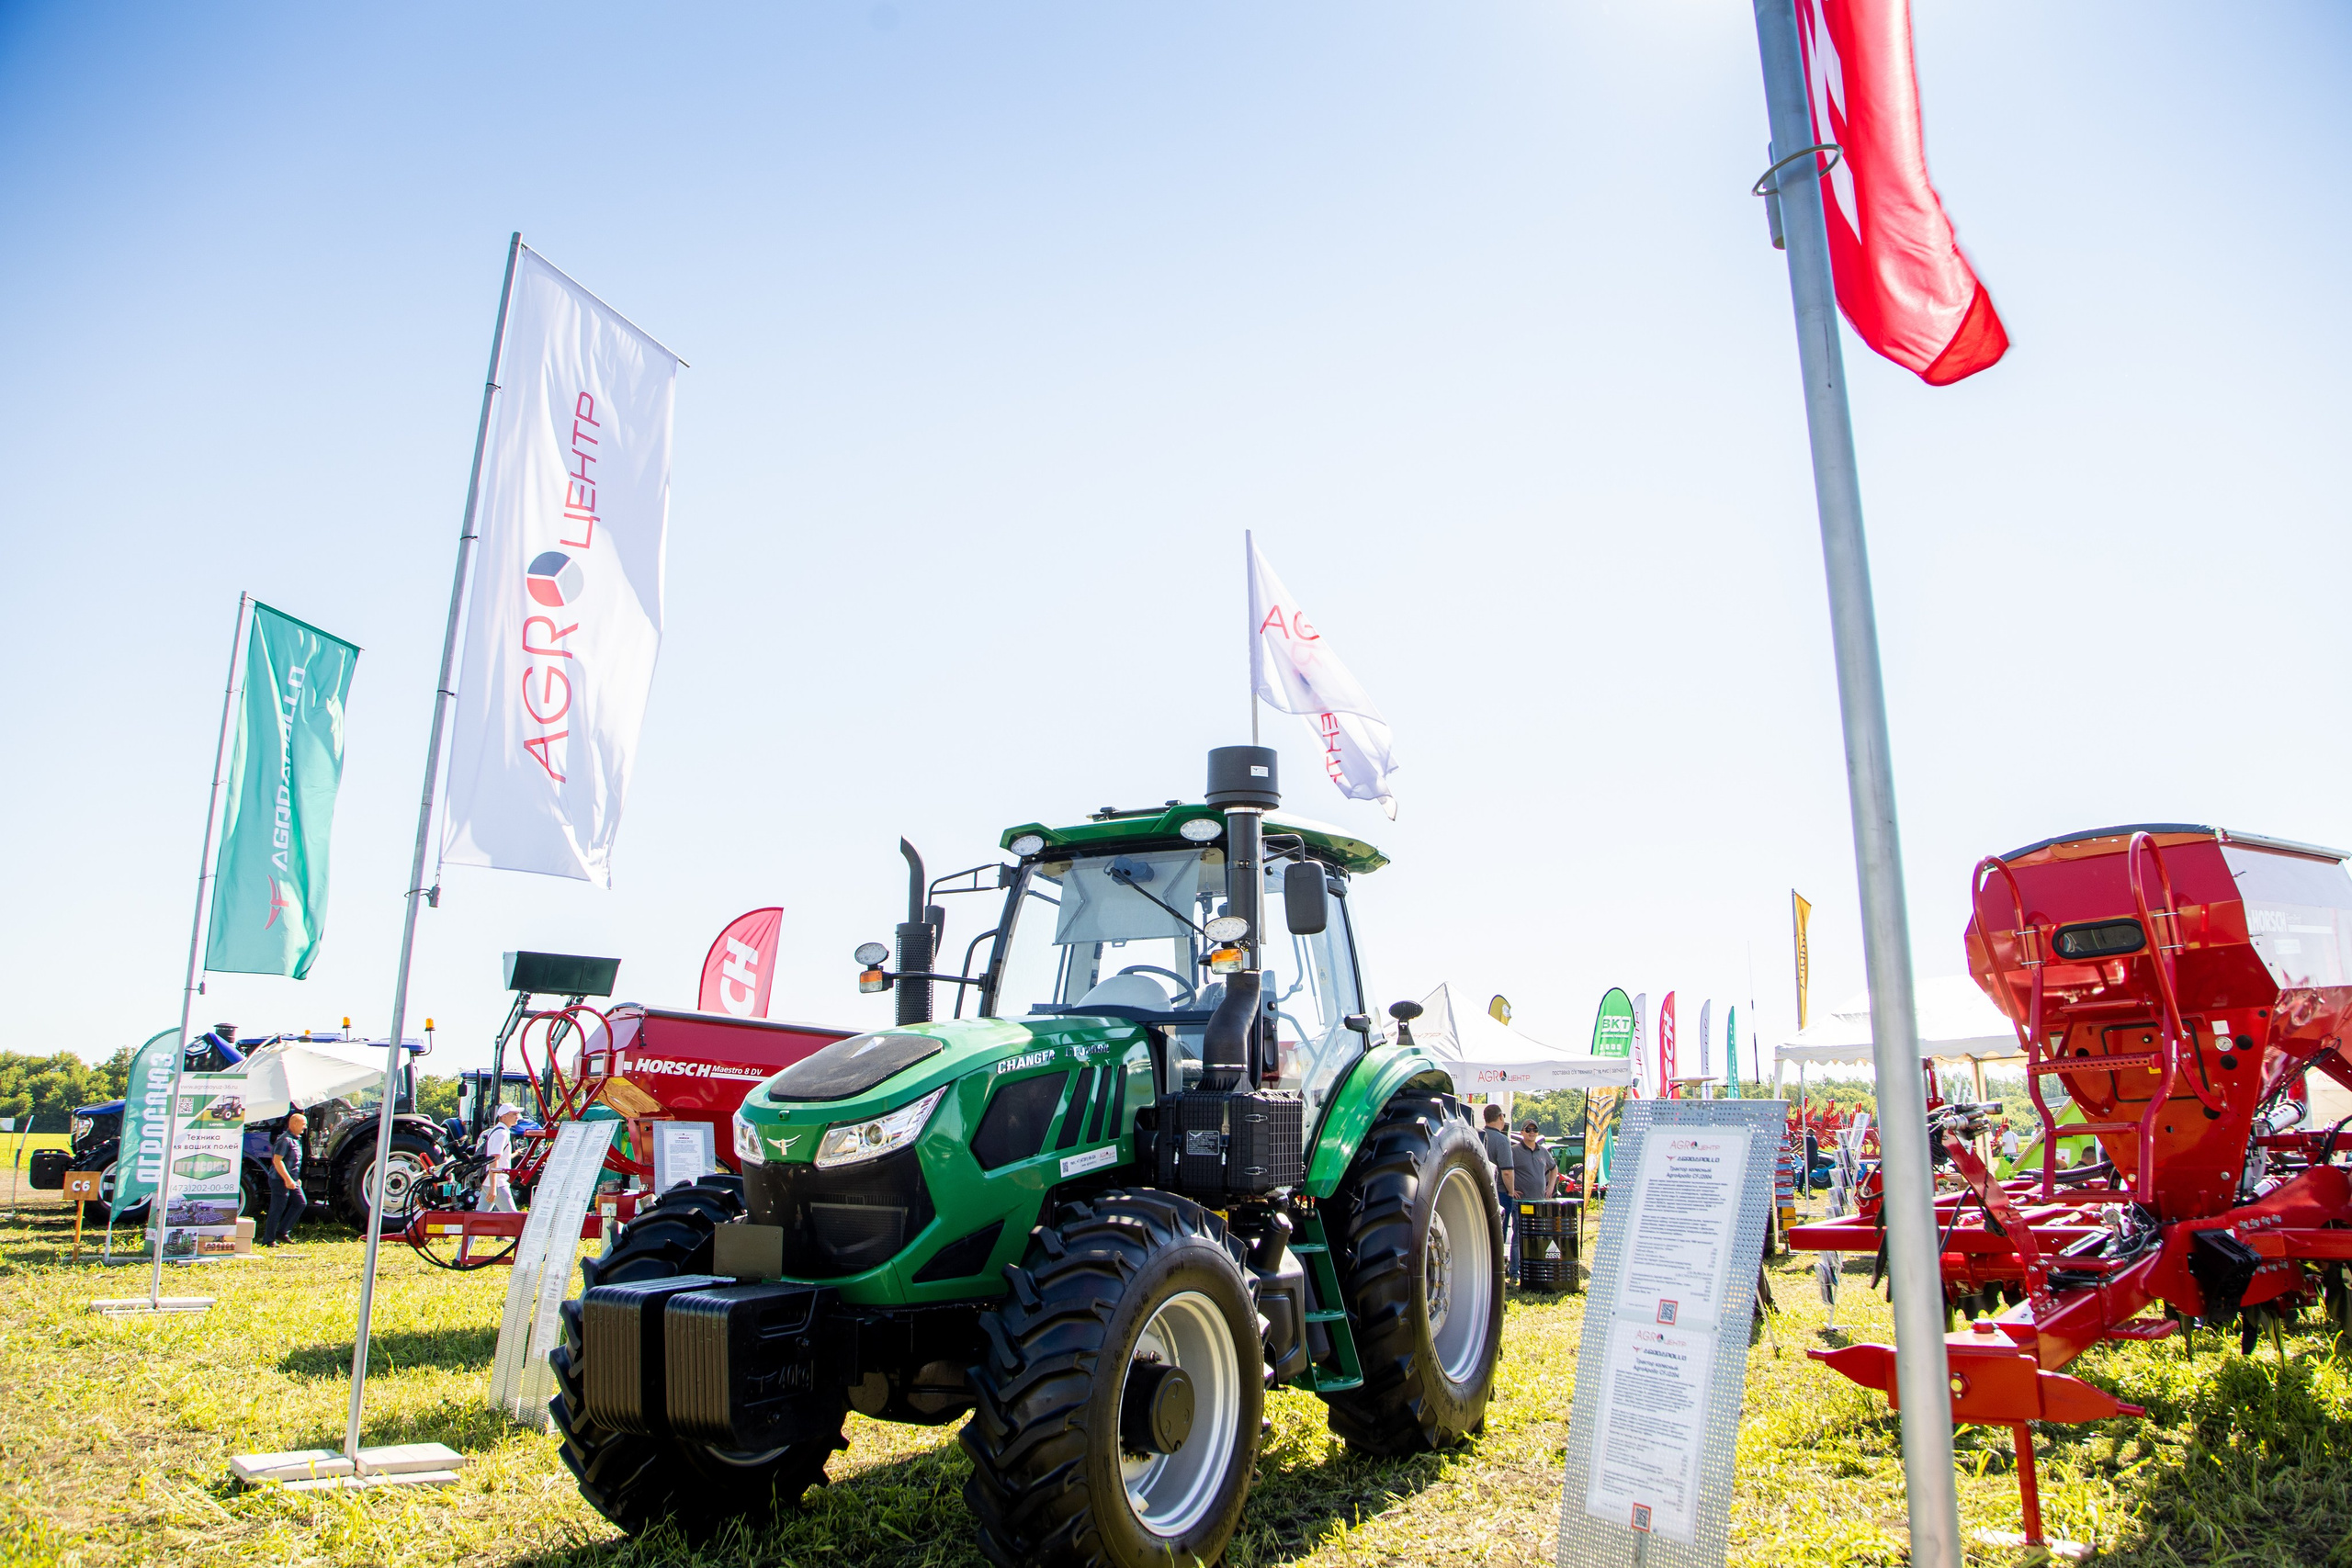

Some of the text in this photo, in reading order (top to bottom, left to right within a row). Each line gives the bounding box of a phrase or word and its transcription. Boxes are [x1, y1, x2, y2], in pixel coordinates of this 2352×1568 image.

[2250, 909, 2288, 933] HORSCH
[1602, 1017, 1630, 1031] BKT
[635, 1058, 712, 1077] HORSCH
[712, 1066, 742, 1075] Maestro
[997, 1049, 1056, 1075] CHANGFA
[1508, 1075, 1531, 1083] ЦЕНТР
[170, 1183, 235, 1192] (473)202-00-98
